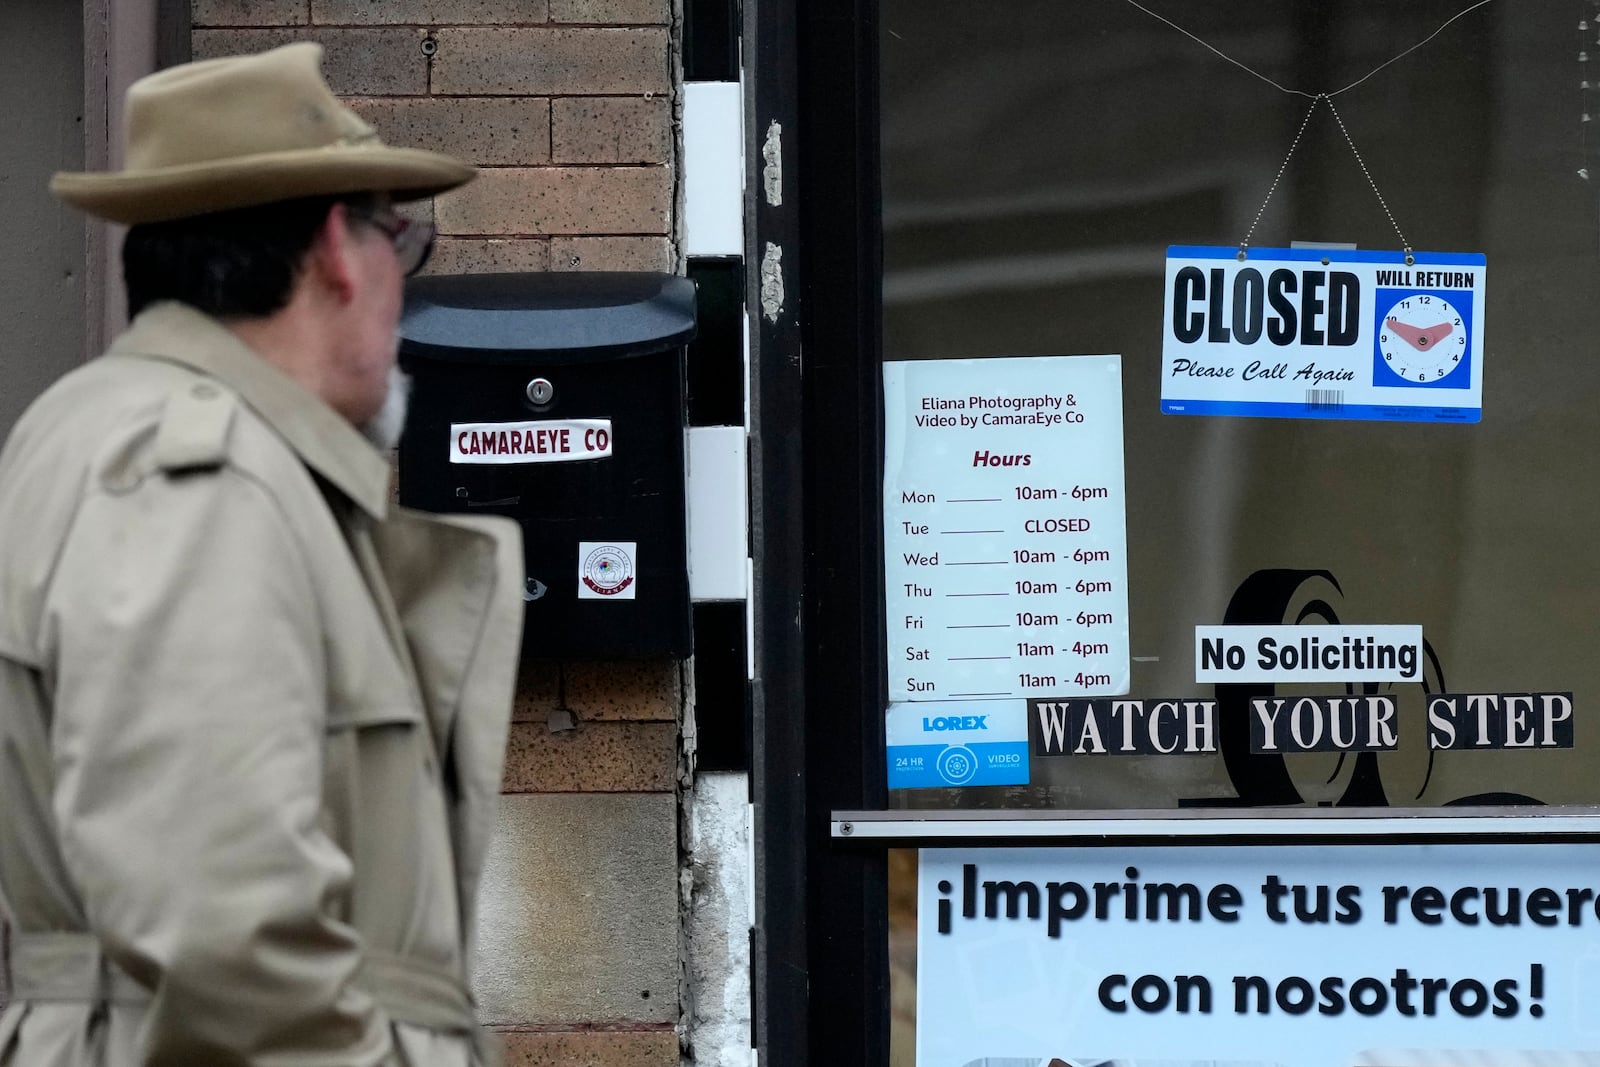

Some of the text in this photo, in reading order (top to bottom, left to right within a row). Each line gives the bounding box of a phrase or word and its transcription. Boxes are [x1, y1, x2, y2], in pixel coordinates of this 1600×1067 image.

[1376, 271, 1474, 288] WILL RETURN
[1173, 266, 1360, 346] CLOSED
[1400, 301, 1410, 309] 11
[1418, 296, 1431, 305] 12
[1442, 303, 1448, 311] 1
[1454, 318, 1461, 326] 2
[1381, 335, 1387, 343] 9
[1459, 337, 1465, 345] 3
[1386, 352, 1392, 361] 8
[1452, 354, 1459, 362] 4
[1172, 358, 1354, 386] Please Call Again
[1400, 368, 1406, 376] 7
[1419, 373, 1425, 381] 6
[1438, 368, 1444, 376] 5
[922, 393, 1077, 411] Eliana Photography &
[915, 411, 1084, 428] Video by CamaraEye Co
[458, 428, 609, 455] CAMARAEYE CO
[973, 450, 1032, 467] Hours
[902, 490, 936, 504] Mon
[1015, 486, 1057, 500] 10am
[1072, 485, 1108, 501] 6pm
[903, 518, 1091, 535] Tue CLOSED
[904, 552, 939, 566] Wed
[1013, 549, 1056, 563] 10am
[1073, 548, 1110, 564] 6pm
[904, 583, 932, 597] Thu
[1015, 580, 1058, 594] 10am
[1075, 579, 1112, 595] 6pm
[905, 615, 923, 629] Fri
[1016, 612, 1059, 626] 10am
[1076, 611, 1113, 627] 6pm
[906, 646, 930, 661] Sat
[1017, 642, 1054, 656] 11am
[1072, 641, 1109, 657] 4pm
[1201, 636, 1417, 677] No Soliciting
[907, 678, 935, 692] Sun
[1019, 673, 1056, 687] 11am
[1074, 672, 1111, 688] 4pm
[923, 716, 988, 731] LOREX
[1037, 695, 1572, 753] WATCH YOUR STEP
[896, 757, 923, 766] 24 HR
[988, 754, 1020, 763] VIDEO
[938, 864, 1600, 938] ¡Imprime tus recuer
[1098, 963, 1545, 1018] con nosotros!
